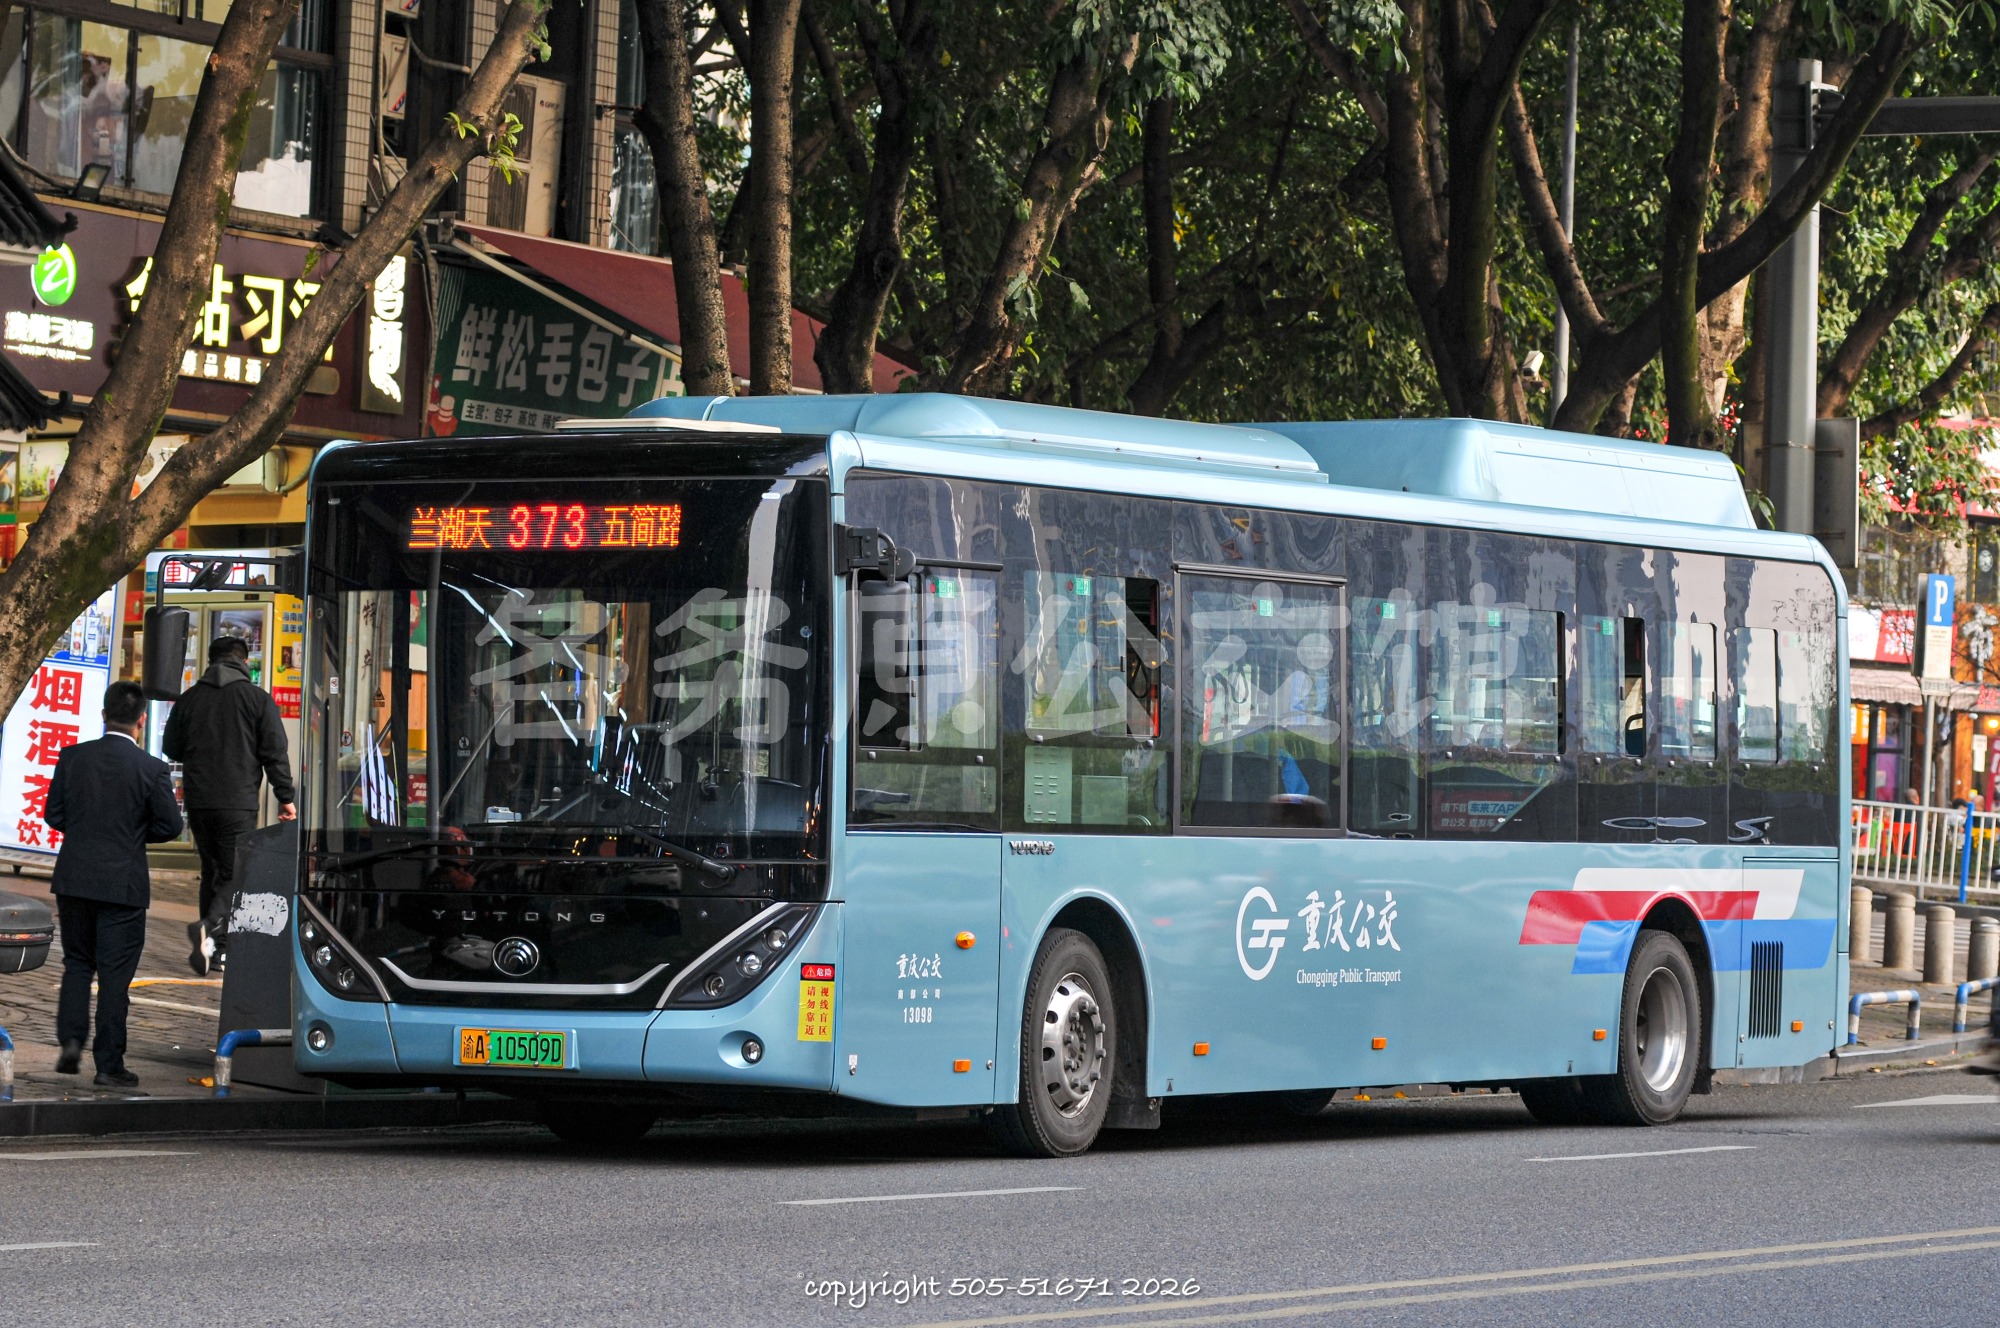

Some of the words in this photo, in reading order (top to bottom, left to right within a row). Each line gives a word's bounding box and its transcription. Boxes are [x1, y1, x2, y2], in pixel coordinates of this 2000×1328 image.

[409, 507, 492, 548] 兰湖天
[509, 505, 585, 548] 373
[600, 504, 681, 547] 五简路
[1933, 580, 1949, 622] P
[1009, 841, 1055, 855] YUTONG
[432, 910, 605, 923] YUTONG
[1297, 890, 1401, 952] 重庆公交
[816, 967, 832, 977] 危险
[896, 953, 942, 979] 重庆公交
[1296, 969, 1338, 987] Chongqing
[1339, 968, 1363, 983] Public
[1364, 968, 1401, 986] Transport
[804, 986, 816, 1035] 请勿靠近
[818, 987, 829, 1035] 视线盲区
[903, 1007, 932, 1024] 13098
